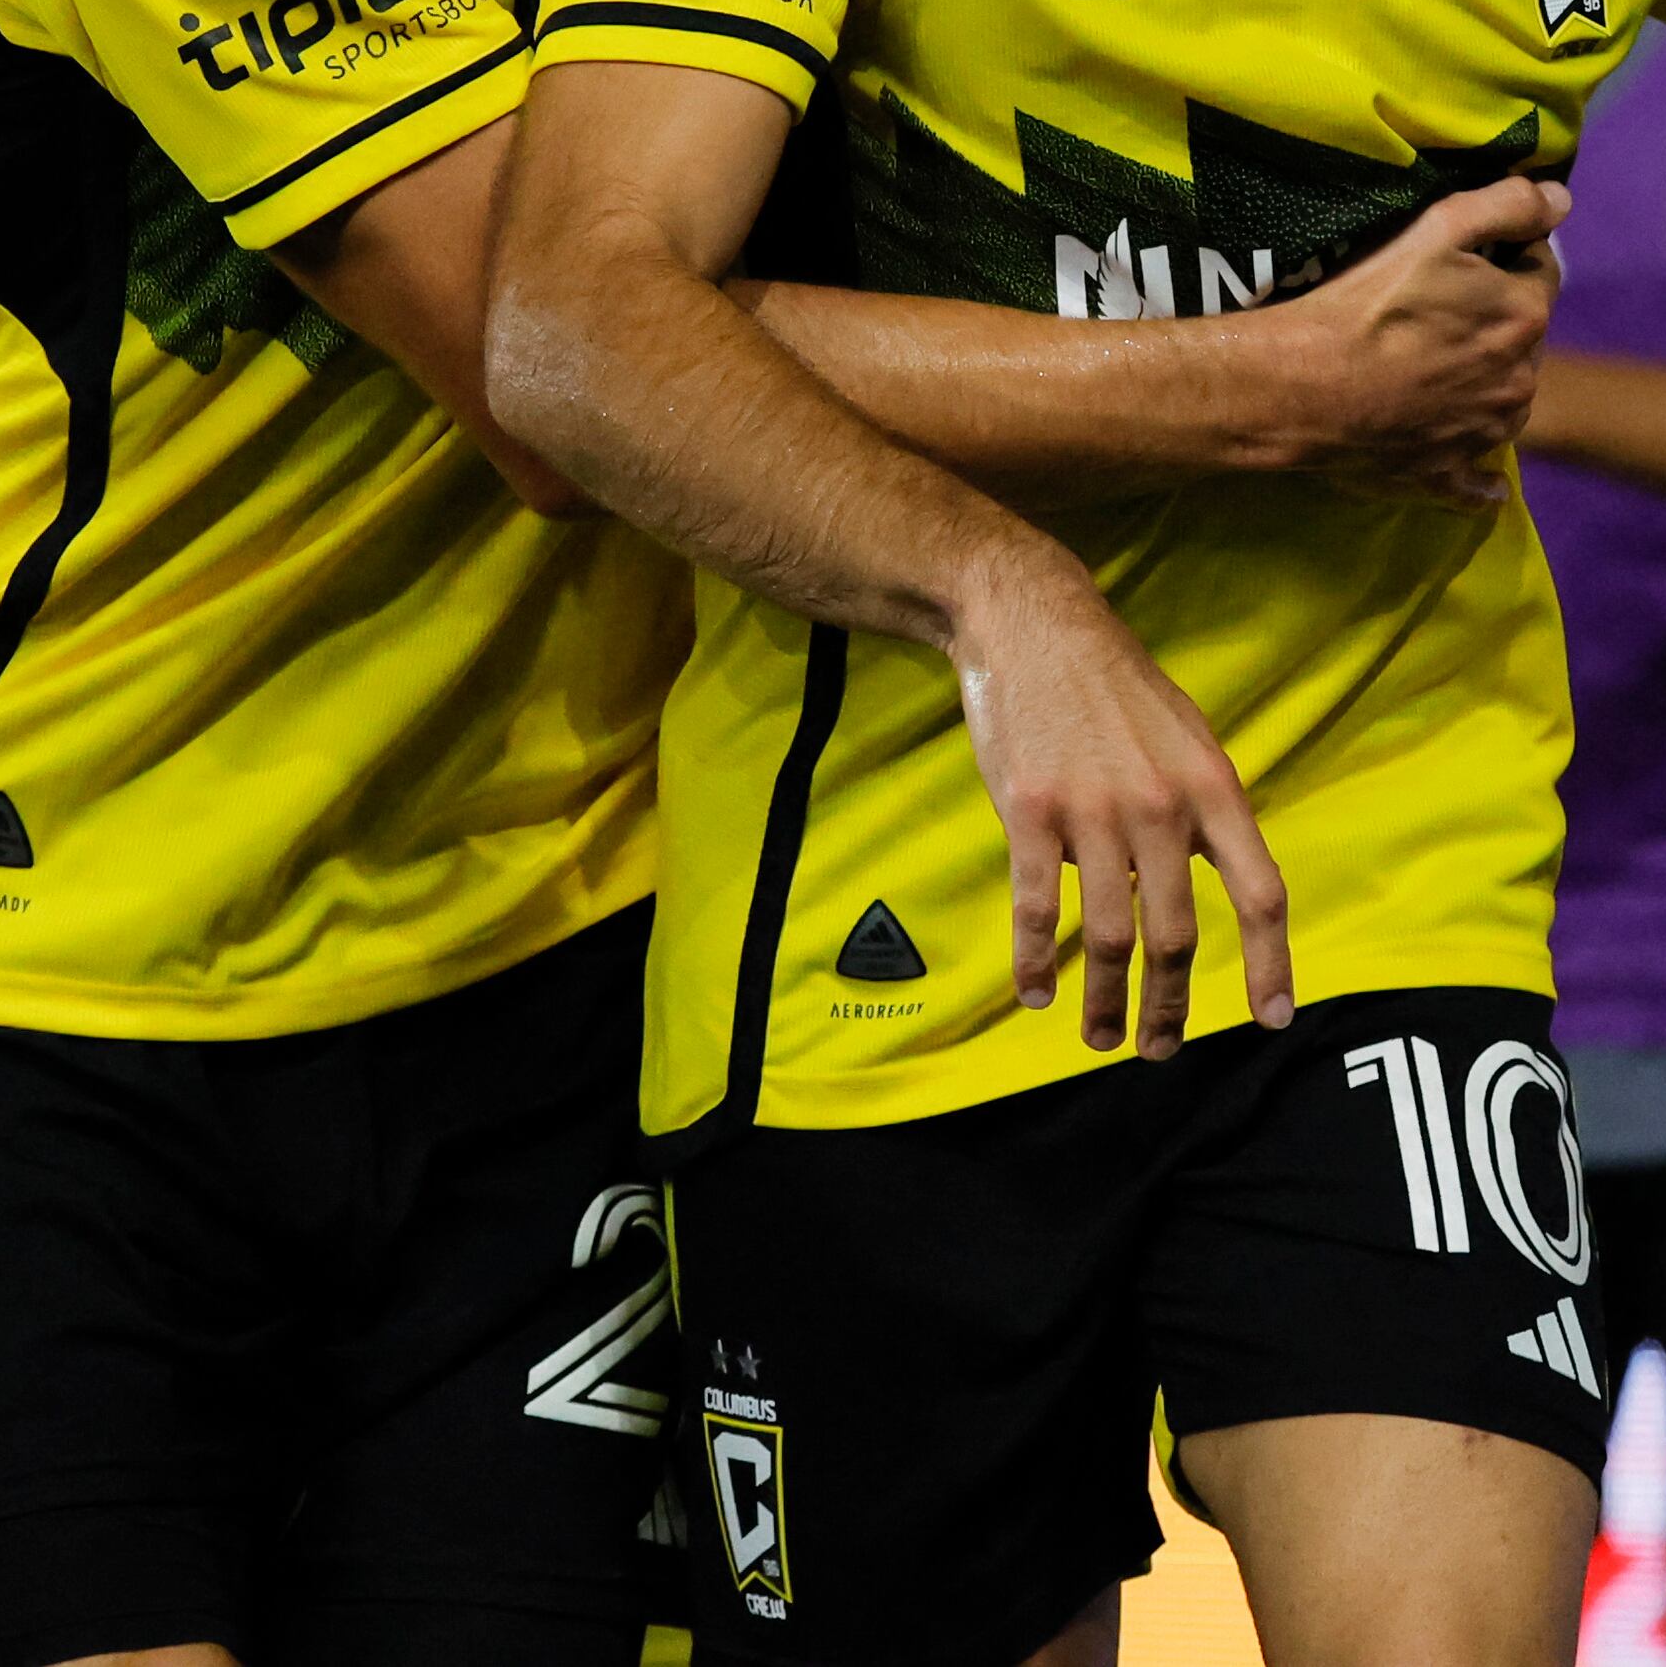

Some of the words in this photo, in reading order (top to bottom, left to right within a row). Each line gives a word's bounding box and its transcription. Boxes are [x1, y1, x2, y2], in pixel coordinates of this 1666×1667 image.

[830, 1002, 925, 1020] AEROREADY
[1343, 1036, 1591, 1286] 10
[704, 1387, 777, 1423] COLUMBUS
[746, 1593, 786, 1620] CREW
